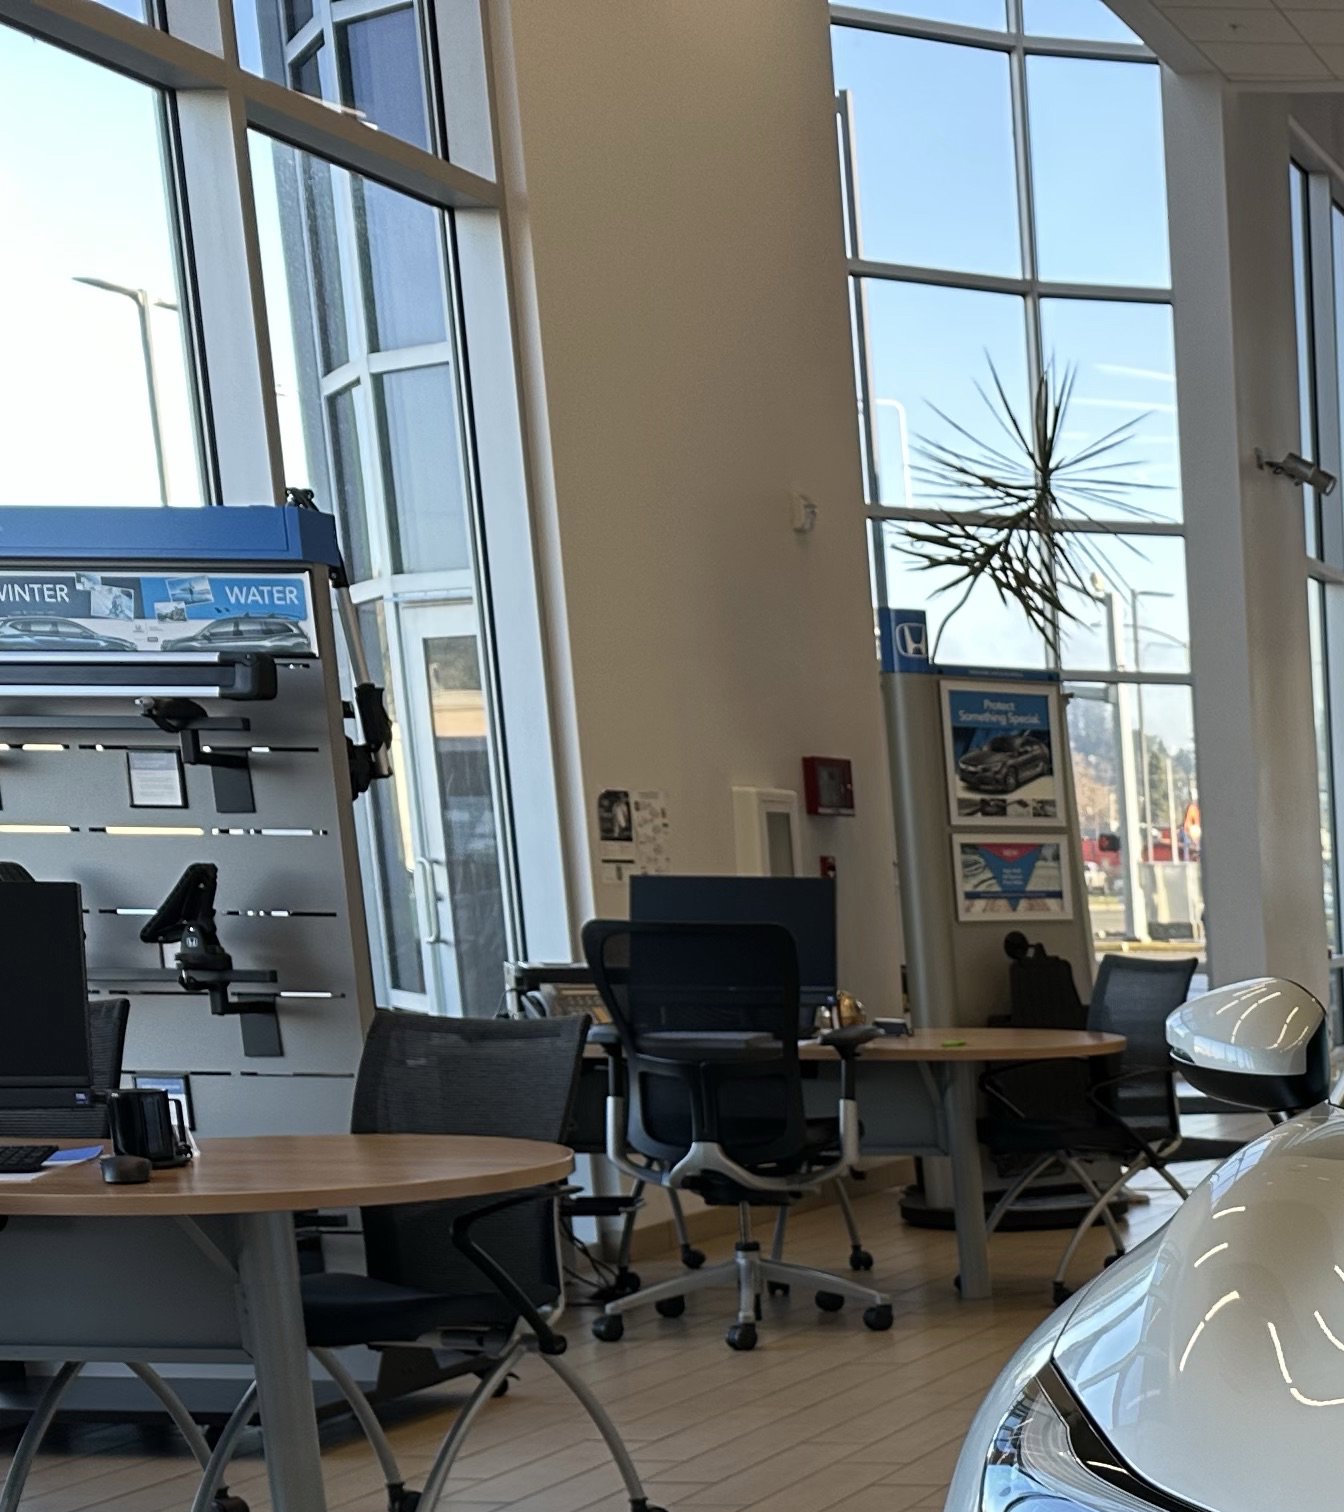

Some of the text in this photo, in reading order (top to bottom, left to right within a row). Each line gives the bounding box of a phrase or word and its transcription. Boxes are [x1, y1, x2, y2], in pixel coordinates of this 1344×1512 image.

[225, 584, 299, 605] WATER
[983, 699, 1015, 711] Protect
[958, 710, 1008, 726] Something
